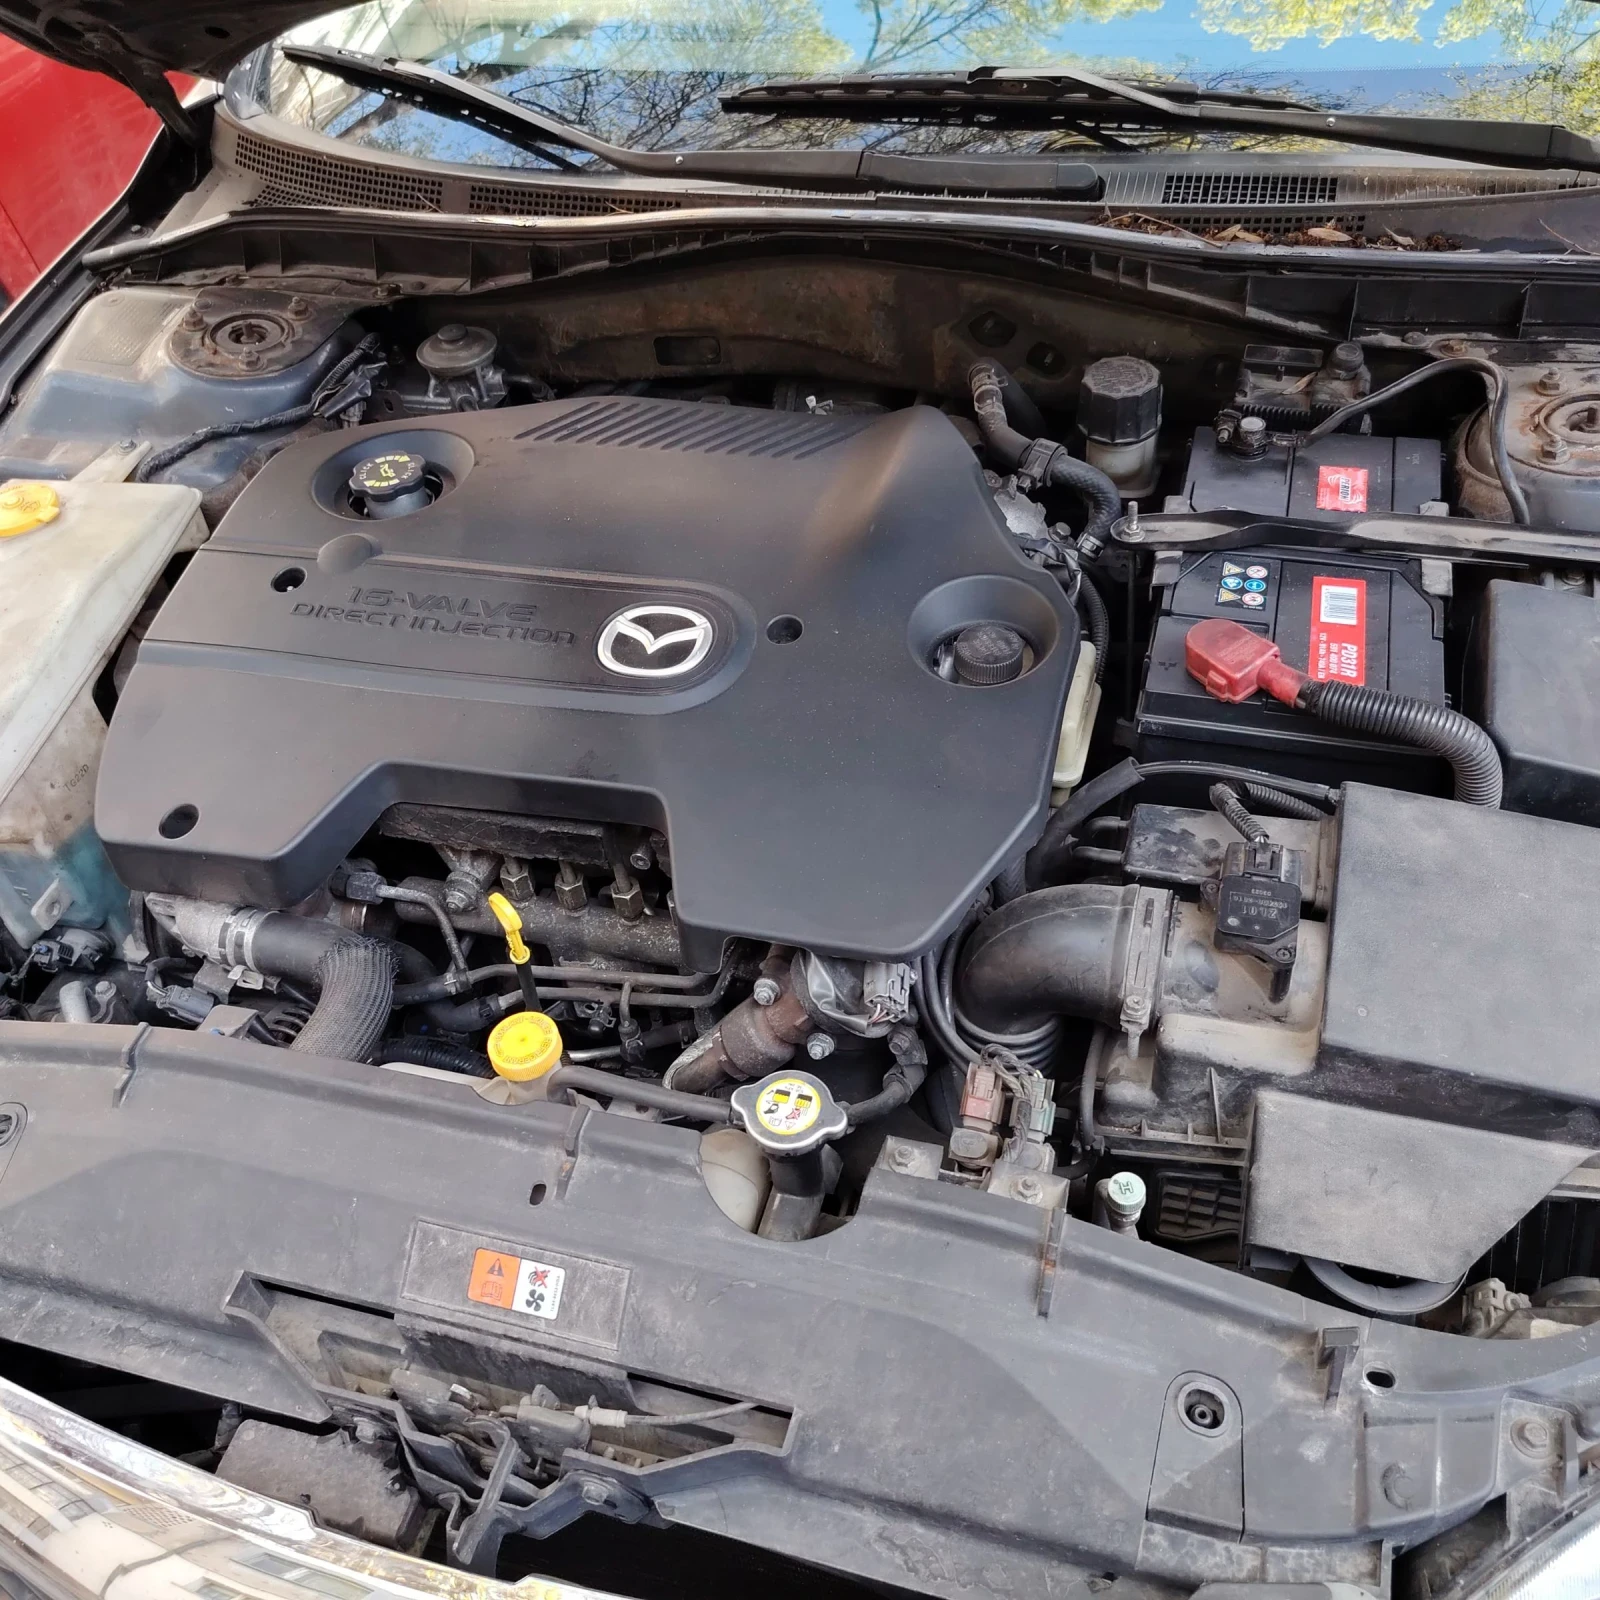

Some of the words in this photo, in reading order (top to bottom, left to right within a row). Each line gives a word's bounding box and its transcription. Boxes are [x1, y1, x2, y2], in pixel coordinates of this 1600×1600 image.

[359, 462, 374, 480] CLICK
[401, 462, 415, 479] CLICK
[1340, 478, 1350, 501] PERION
[347, 586, 537, 622] 16-VALVE
[290, 602, 406, 627] DIRECT
[408, 615, 576, 644] INJECTION
[1340, 642, 1358, 678] PD31R
[1119, 1180, 1134, 1195] H
